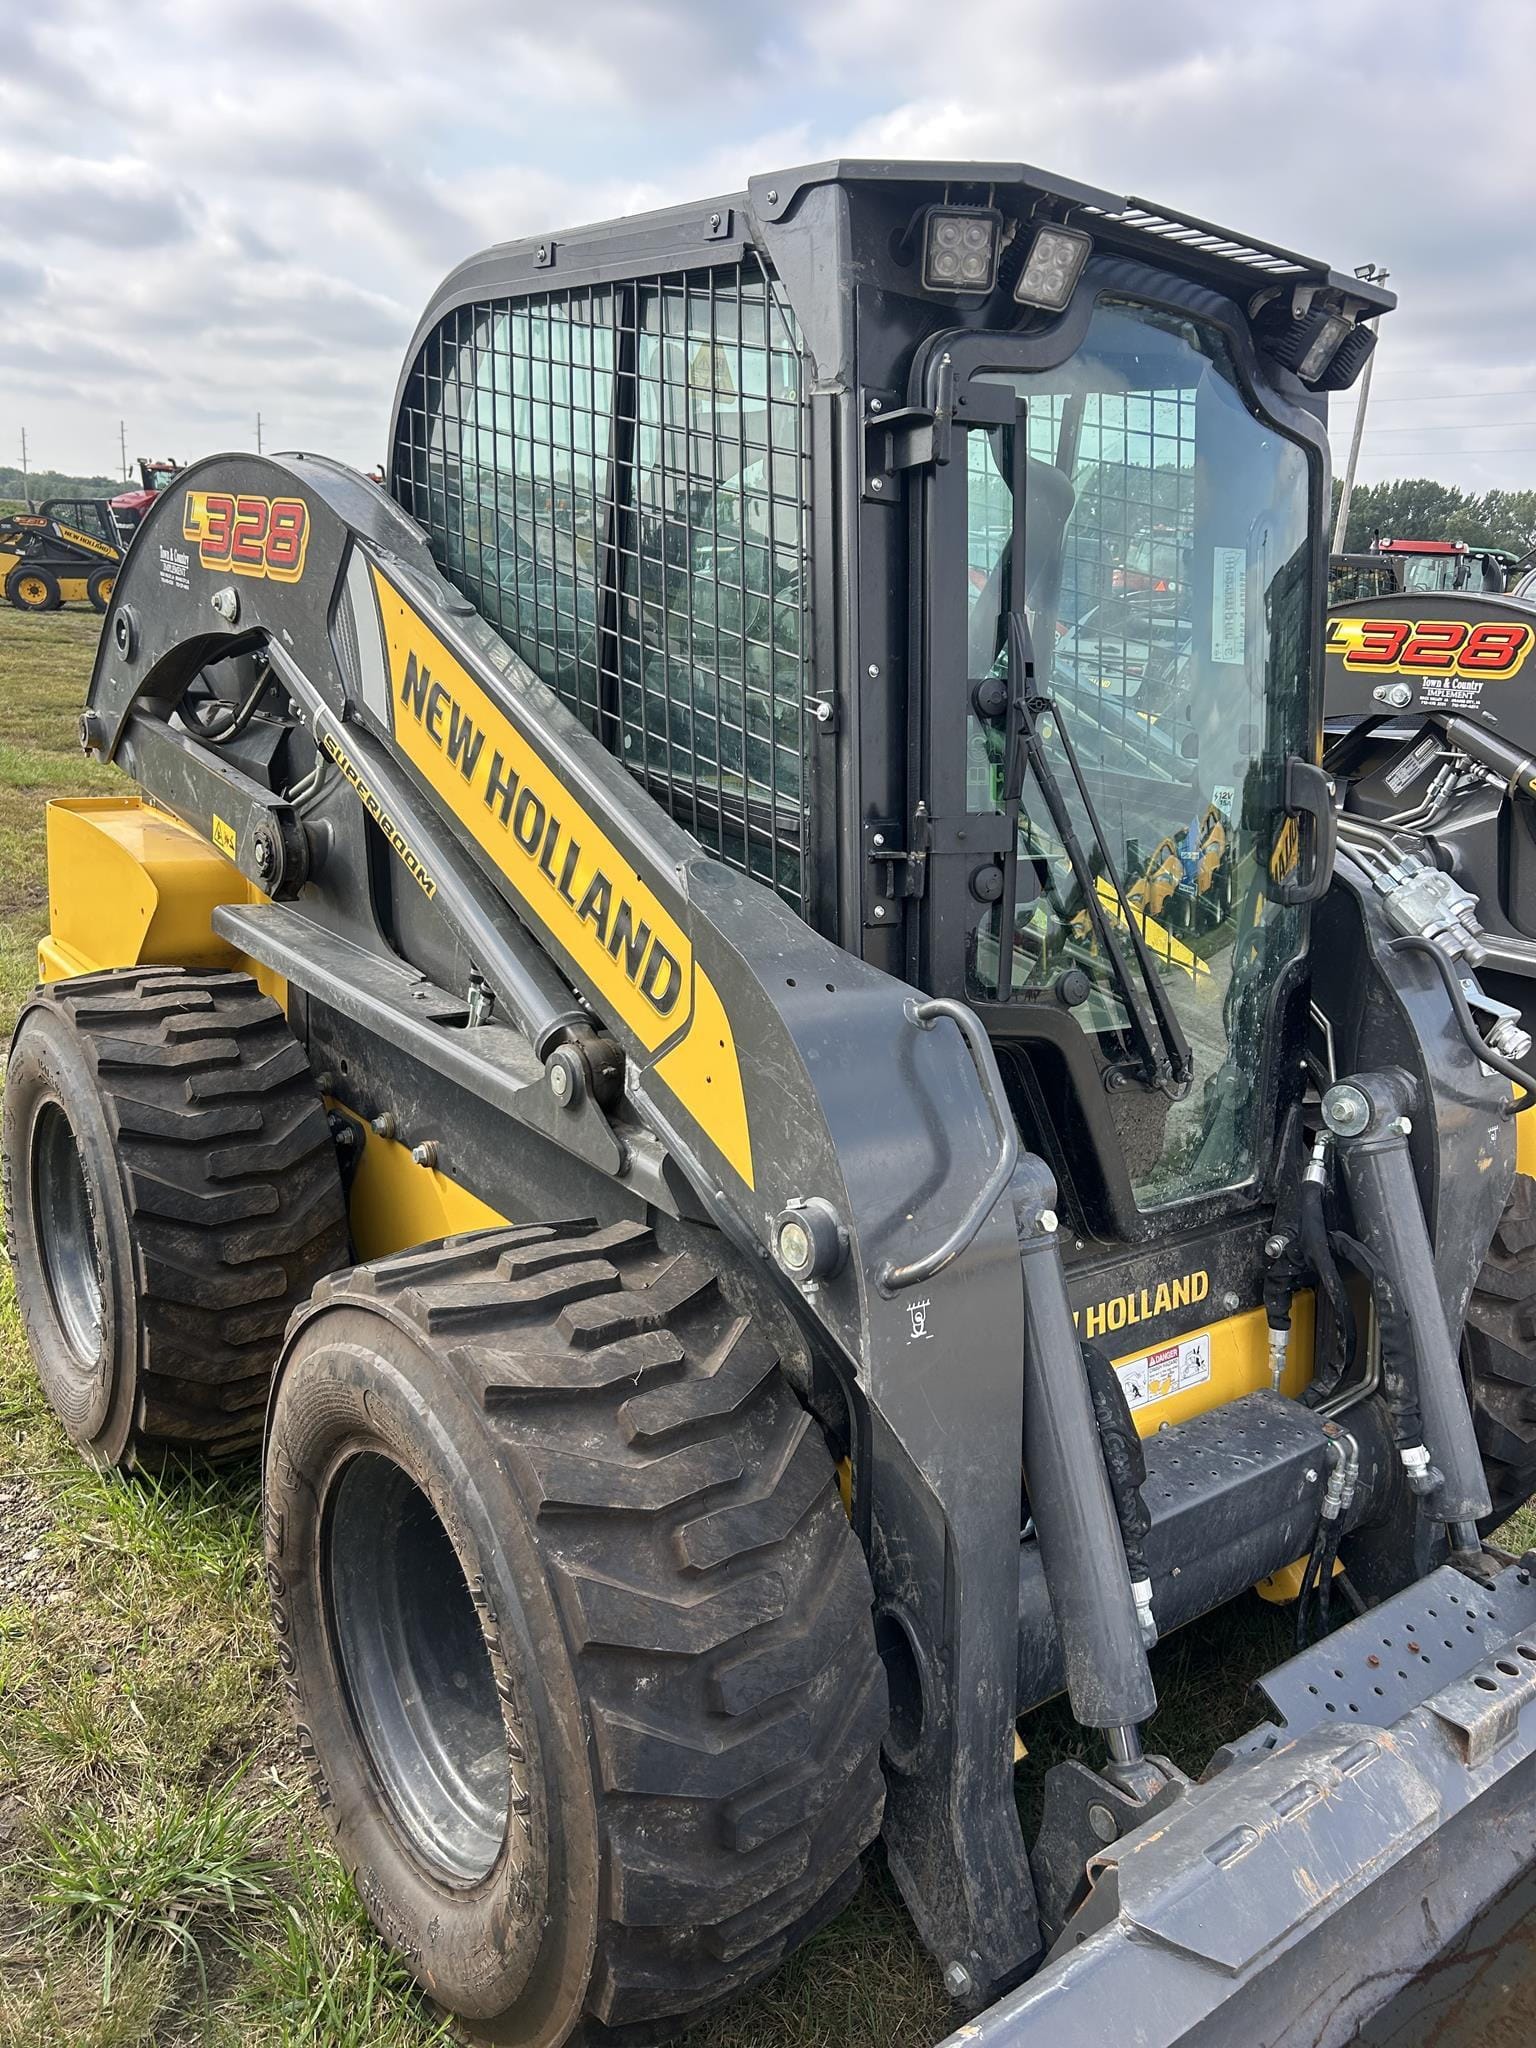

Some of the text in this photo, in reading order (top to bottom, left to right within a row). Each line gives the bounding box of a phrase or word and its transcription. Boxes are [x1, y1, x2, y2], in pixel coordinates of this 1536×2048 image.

[79, 537, 110, 554] HOLLAND
[183, 490, 308, 577] L328
[1326, 621, 1529, 672] L328
[1422, 676, 1484, 693] Town & Country
[1427, 689, 1474, 699] IMPLEMENT
[323, 733, 437, 900] SUPERBOOM
[400, 649, 683, 1018] NEW HOLLAND
[1086, 1270, 1209, 1338] HOLLAND
[1155, 1349, 1178, 1363] DANGER
